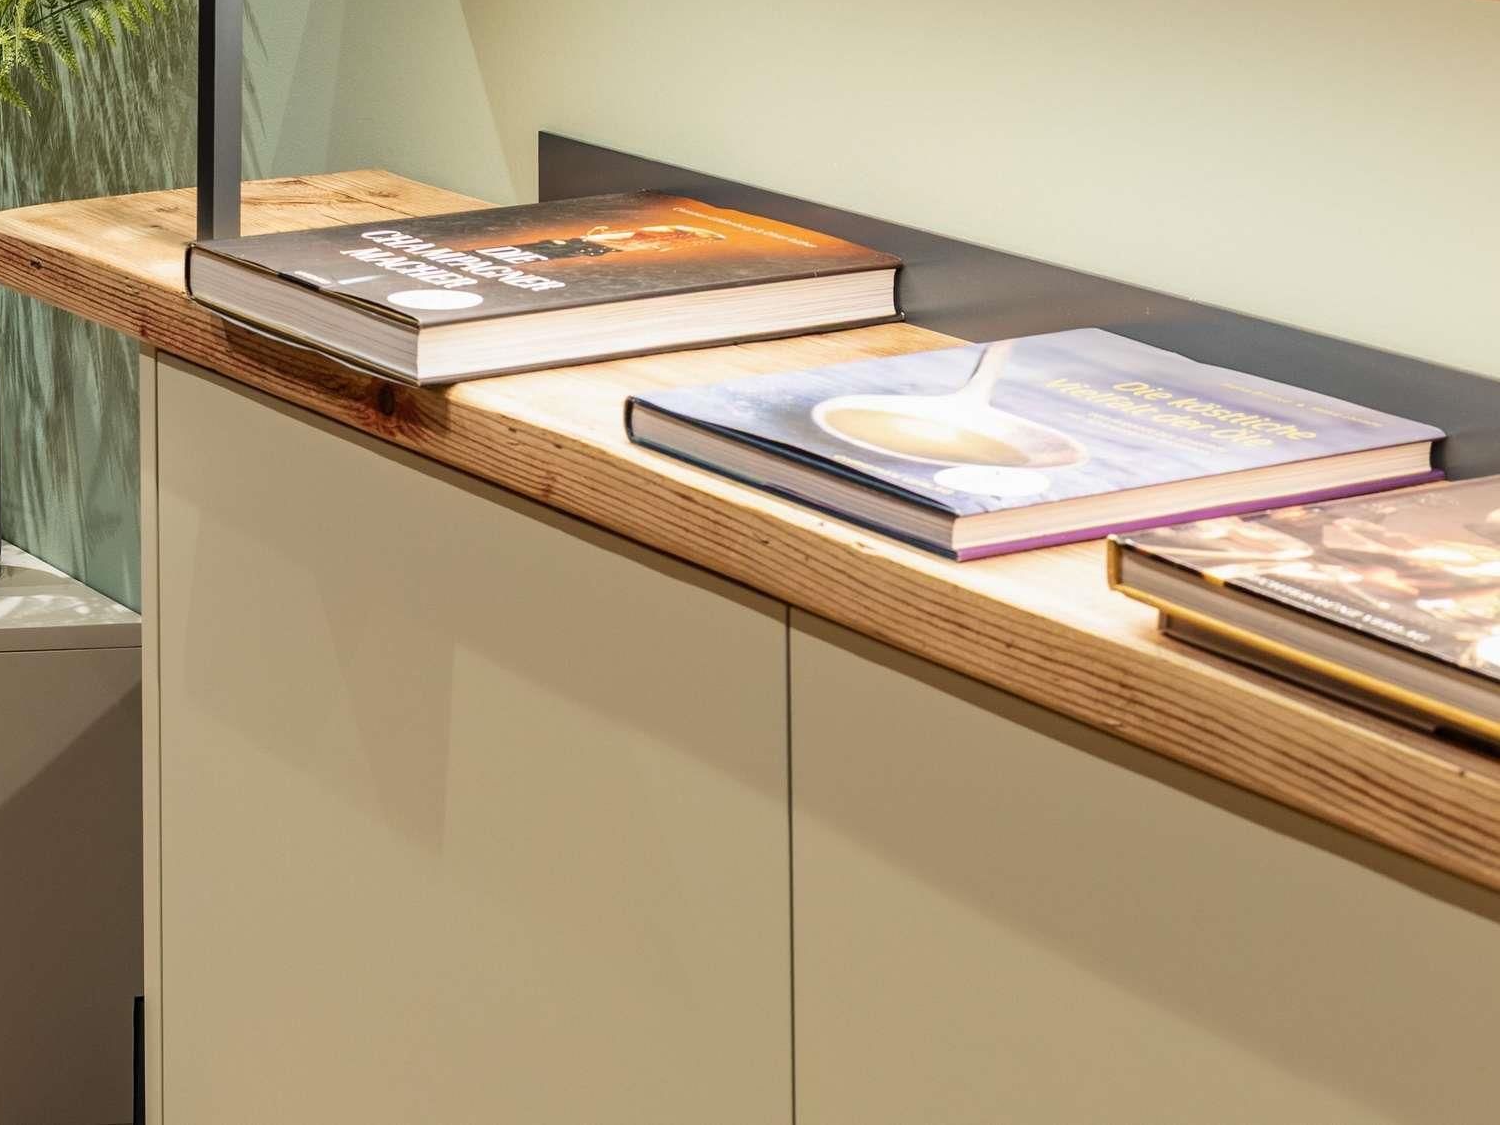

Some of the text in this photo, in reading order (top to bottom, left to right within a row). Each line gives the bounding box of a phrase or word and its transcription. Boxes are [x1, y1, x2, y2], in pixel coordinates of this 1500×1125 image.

[340, 246, 479, 289] MACHER
[360, 229, 566, 292] CHAMPAGNER
[475, 245, 549, 265] DIE
[1045, 377, 1160, 416] Vielfalt
[1153, 412, 1216, 432] der
[1113, 381, 1173, 401] Die
